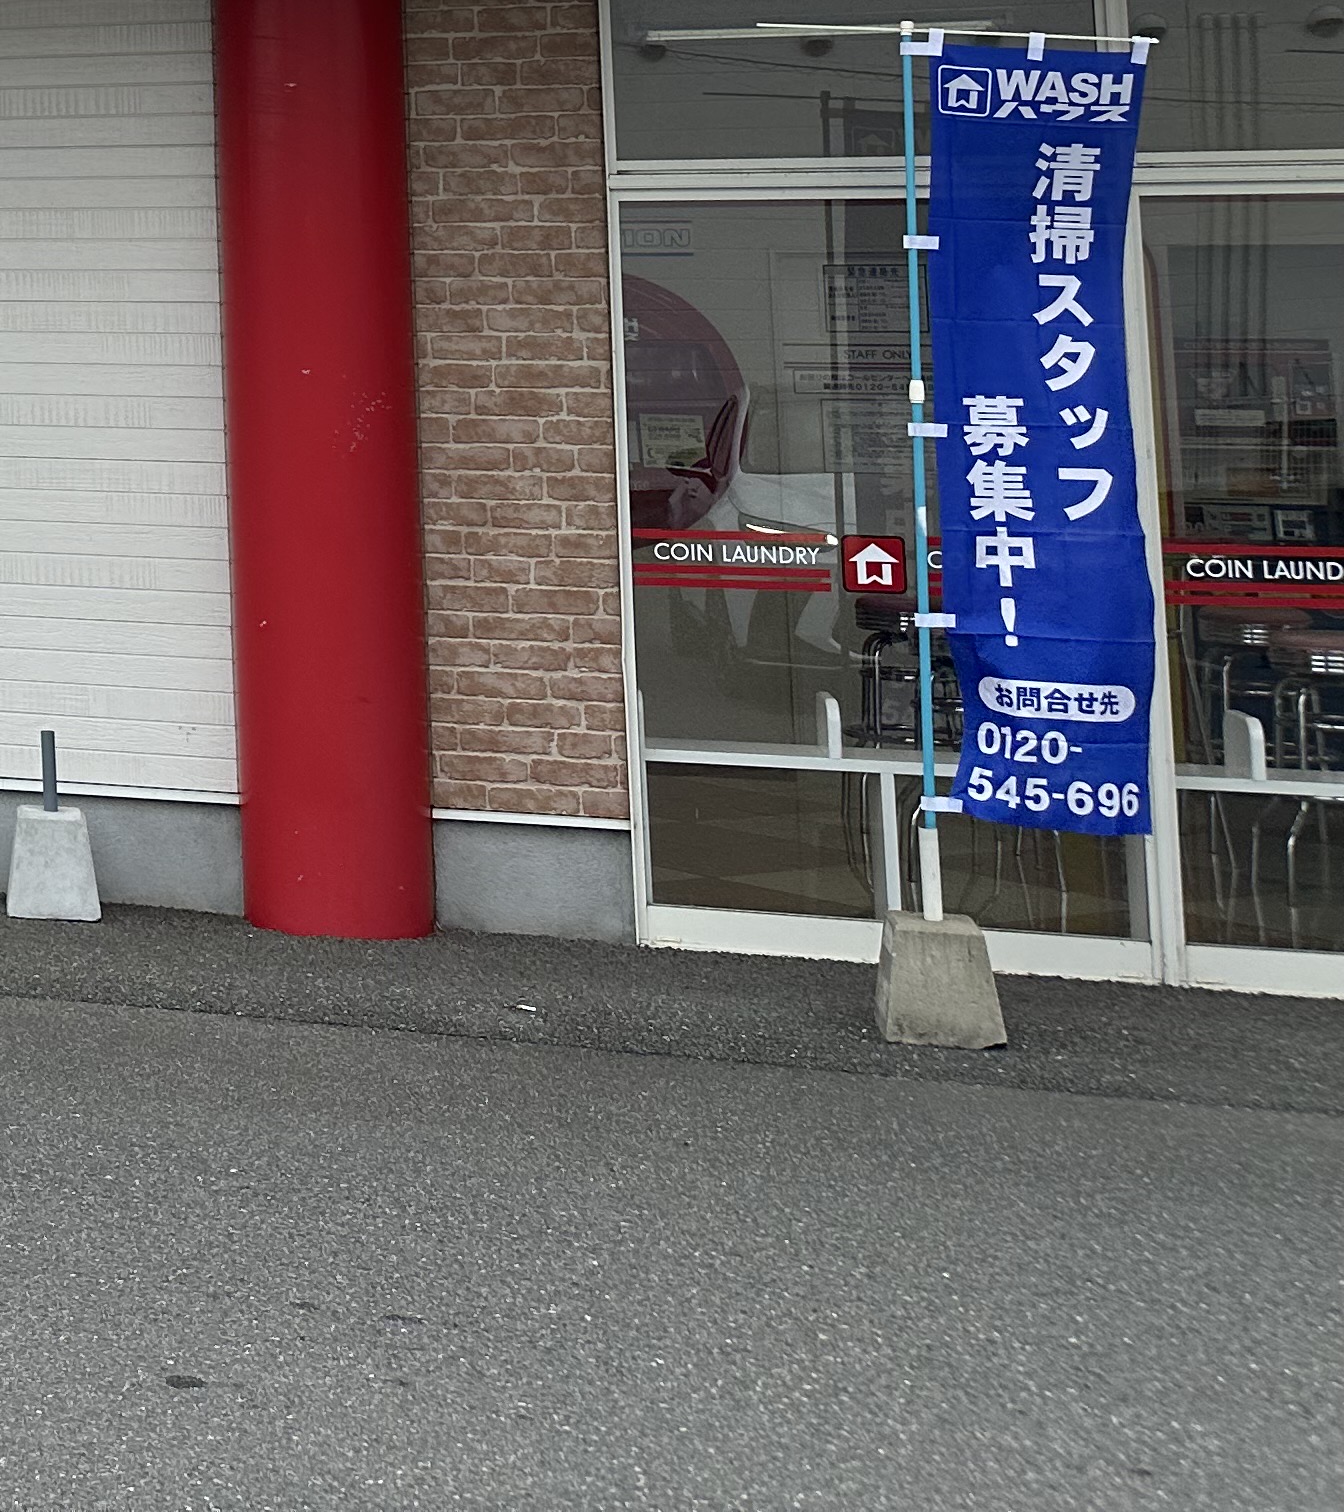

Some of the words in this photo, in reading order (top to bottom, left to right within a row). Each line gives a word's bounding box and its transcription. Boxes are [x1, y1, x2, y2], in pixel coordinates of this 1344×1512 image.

[995, 69, 1134, 104] WASH
[992, 101, 1131, 123] ハウス
[1029, 143, 1115, 521] 清掃スタッフ
[844, 349, 877, 360] STAFF
[961, 395, 1036, 647] 募集中！
[653, 542, 712, 562] COIN
[722, 545, 819, 565] LAUNDRY
[1186, 559, 1254, 579] COIN
[1263, 560, 1344, 581] LAUND
[994, 682, 1120, 717] お問合せ先
[976, 721, 1083, 765] 0120-
[967, 769, 1140, 818] 545-696
